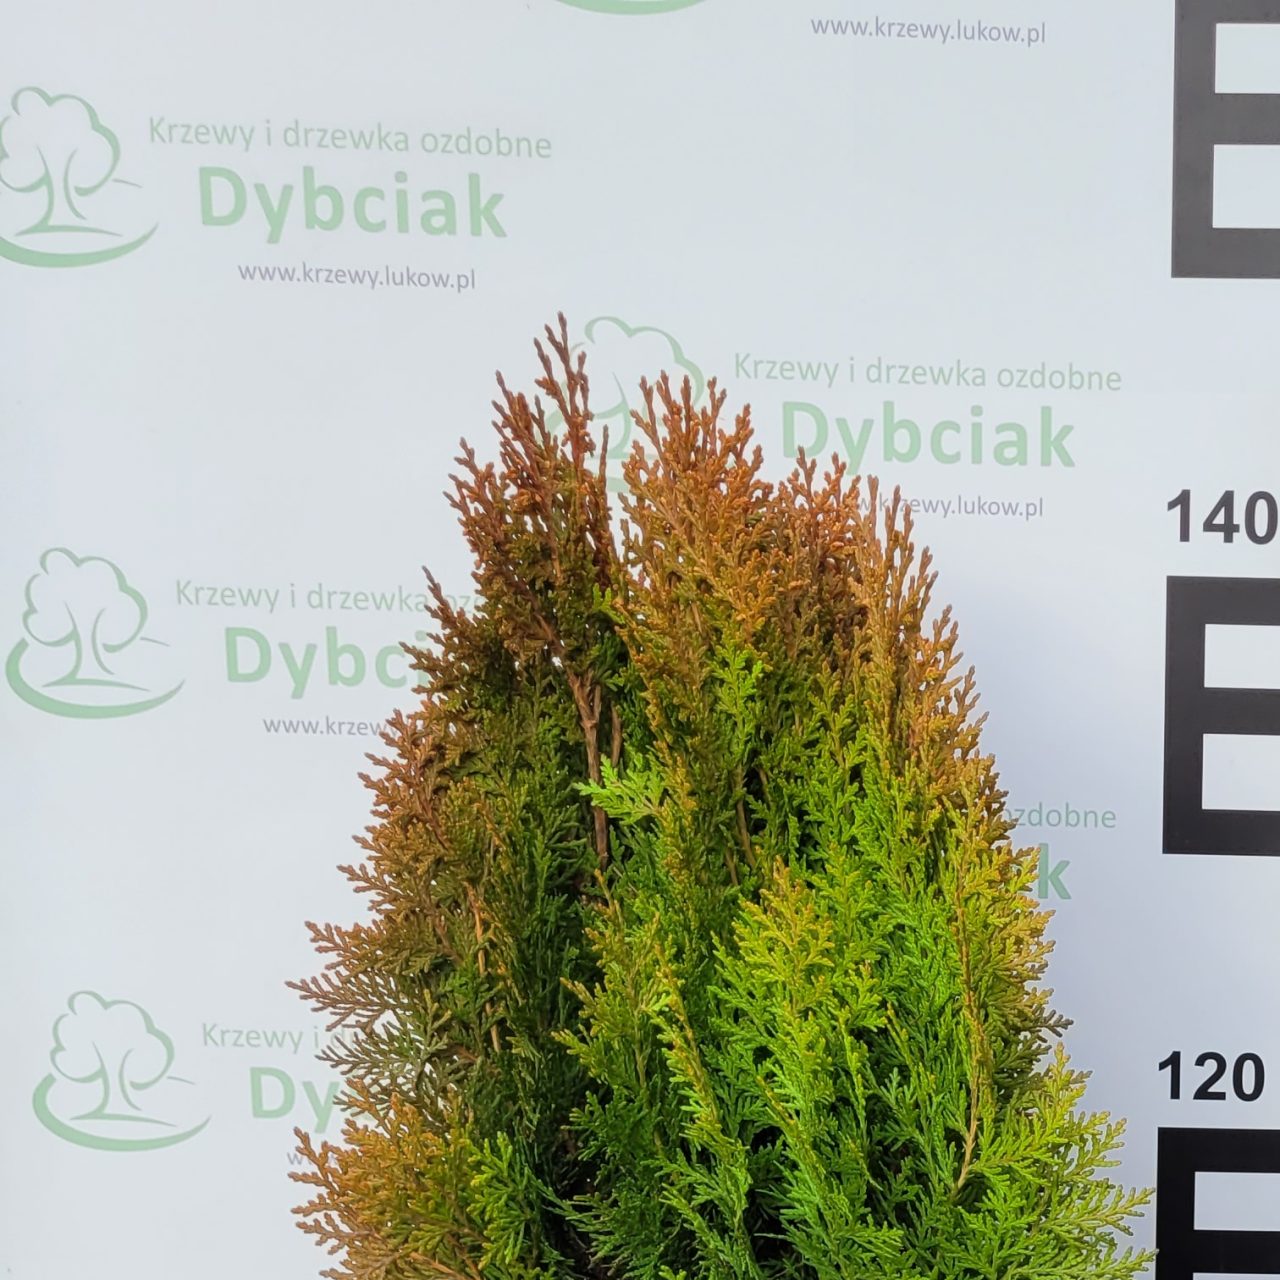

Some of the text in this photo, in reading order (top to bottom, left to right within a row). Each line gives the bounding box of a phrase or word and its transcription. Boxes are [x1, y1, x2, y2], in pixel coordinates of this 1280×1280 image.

[810, 15, 1046, 48] www.krzewy.lukow.pl
[149, 116, 552, 159] Krzewy i drzewka ozdobne
[198, 164, 509, 245] Dybciak
[237, 260, 476, 294] www.krzewy.lukow.pl
[733, 352, 1122, 392] Krzewy i drzewka ozdobne
[781, 399, 1077, 476] Dybciak
[1167, 488, 1279, 546] 140
[175, 579, 280, 615] Krzewy
[289, 582, 296, 609] i
[306, 582, 428, 613] drzewka
[202, 1022, 304, 1055] Krzewy
[313, 1025, 320, 1049] i
[1158, 1050, 1265, 1103] 120
